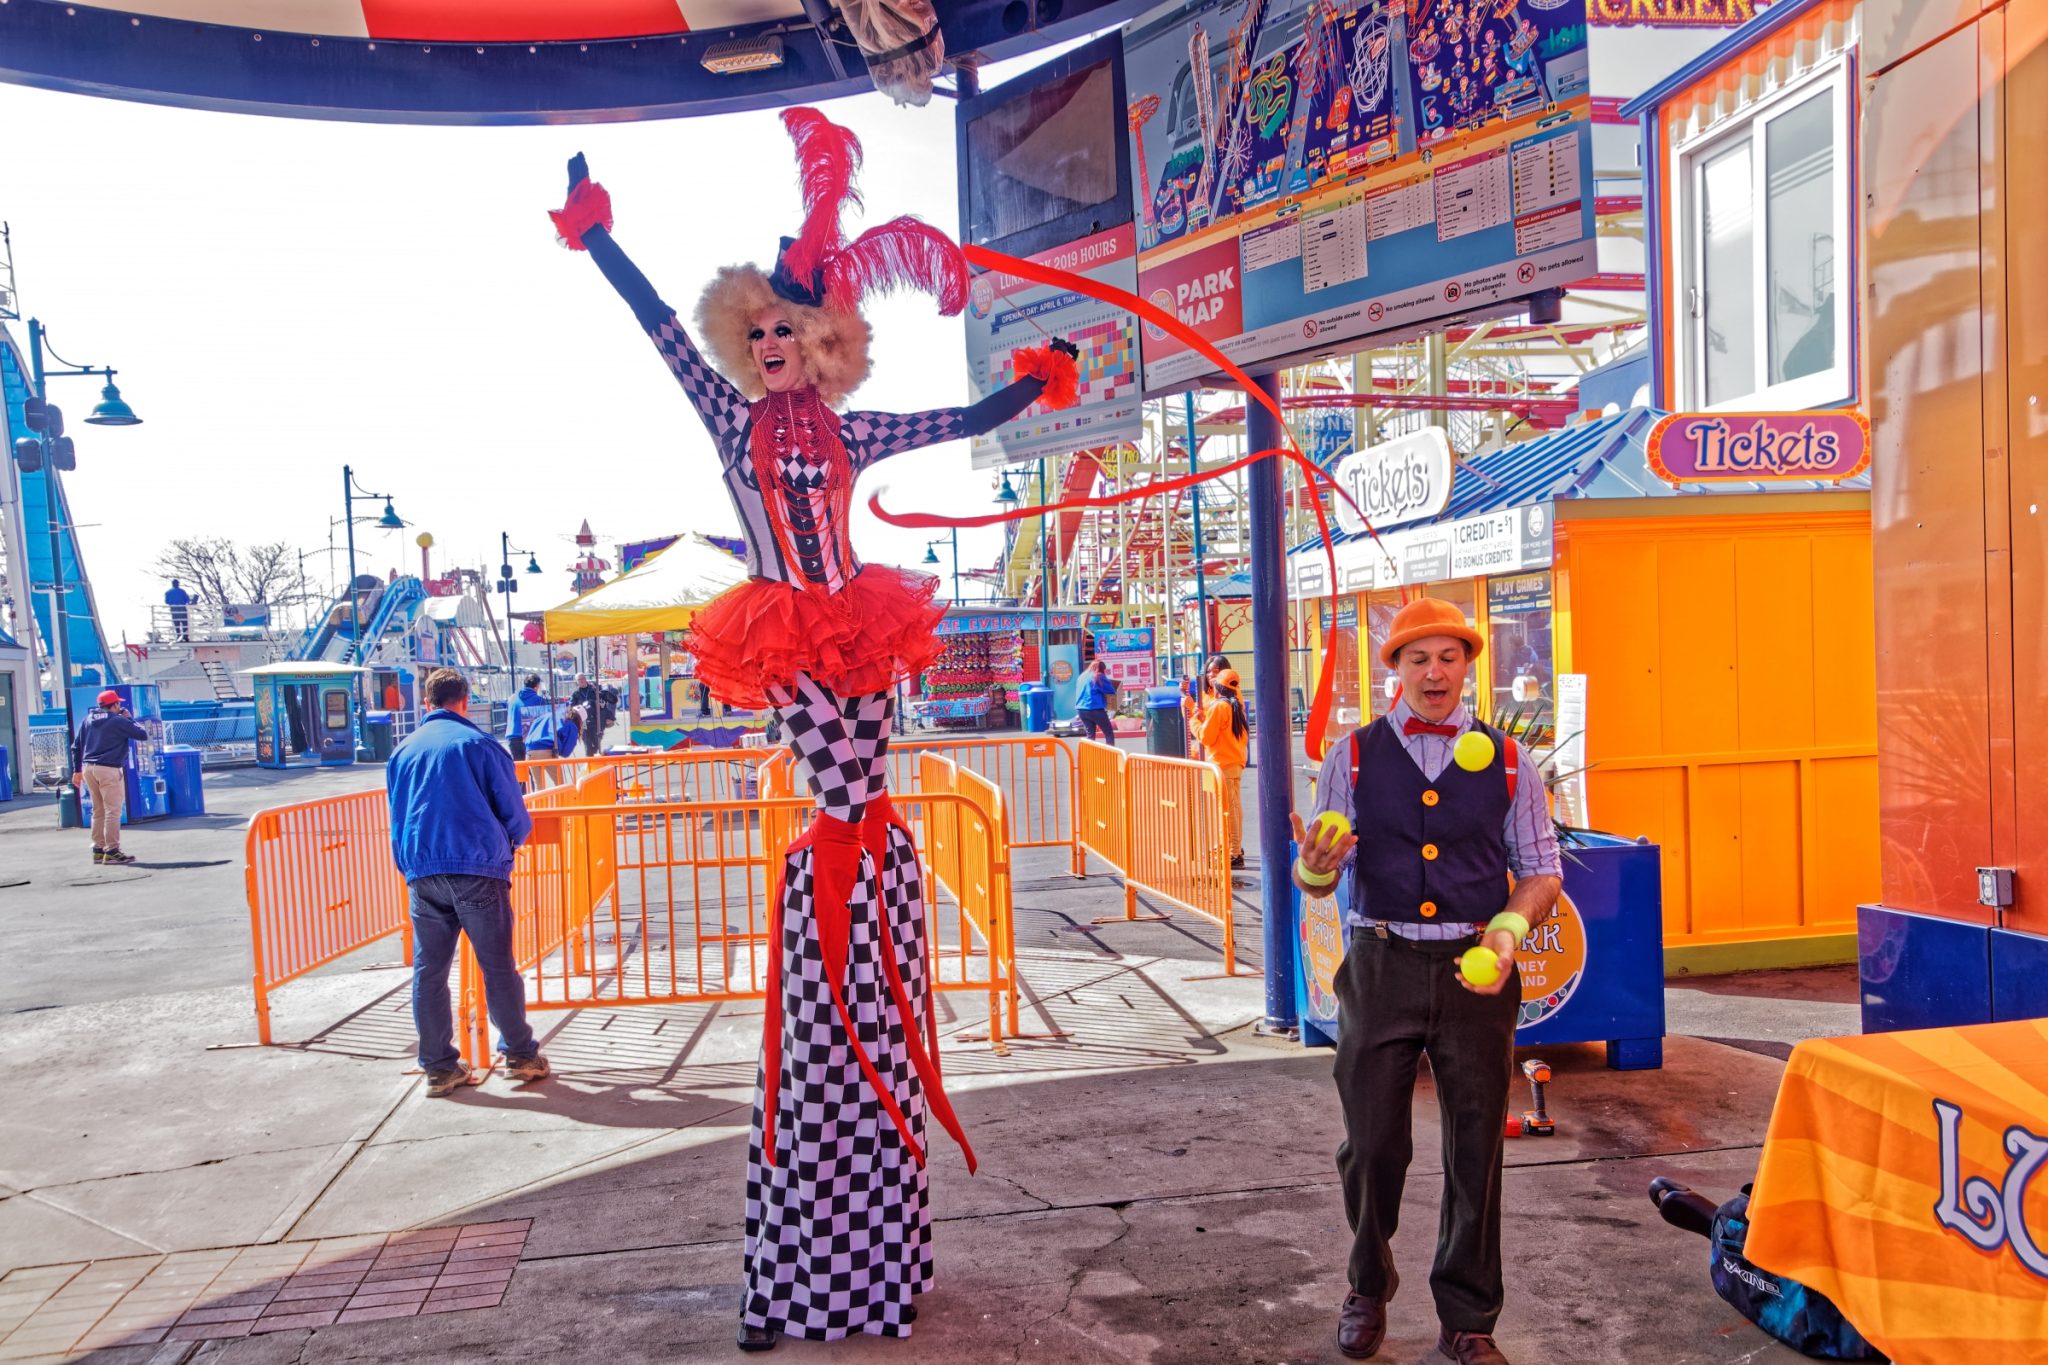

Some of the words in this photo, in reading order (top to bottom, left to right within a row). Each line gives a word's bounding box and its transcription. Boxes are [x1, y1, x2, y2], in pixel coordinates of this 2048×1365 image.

[1541, 207, 1567, 219] BEVERAGE
[1054, 250, 1078, 270] 2019
[1080, 238, 1117, 265] HOURS
[1538, 265, 1547, 273] No
[1547, 261, 1561, 273] pets
[1561, 255, 1584, 268] allowed
[1176, 266, 1235, 306] PARK
[1463, 281, 1471, 289] No
[1472, 276, 1491, 289] photos
[1491, 272, 1507, 284] while
[1464, 288, 1481, 298] riding
[1481, 282, 1502, 295] allowed
[1001, 310, 1026, 324] OPENING
[1026, 307, 1039, 320] DAY:
[1039, 299, 1056, 315] APRIL
[1178, 298, 1225, 328] MAP
[1385, 305, 1393, 313] No
[1393, 299, 1415, 312] smoking
[1415, 294, 1436, 306] allowed
[1318, 318, 1326, 326] No
[1326, 314, 1343, 324] outside
[1343, 310, 1361, 321] alcohol
[1319, 323, 1337, 334] allowed
[1689, 420, 1838, 472] Tickets
[1348, 453, 1429, 515] Tickets
[1459, 519, 1495, 544] CREDIT
[1463, 553, 1484, 569] BONUS
[1484, 549, 1513, 565] CREDITS!
[1495, 581, 1514, 596] PLAY
[1515, 576, 1544, 594] GAMES
[968, 615, 1024, 629] EVERY
[1031, 614, 1080, 628] TME
[1311, 916, 1337, 955] PARK
[1521, 924, 1565, 954] RK
[1517, 960, 1548, 973] NEY
